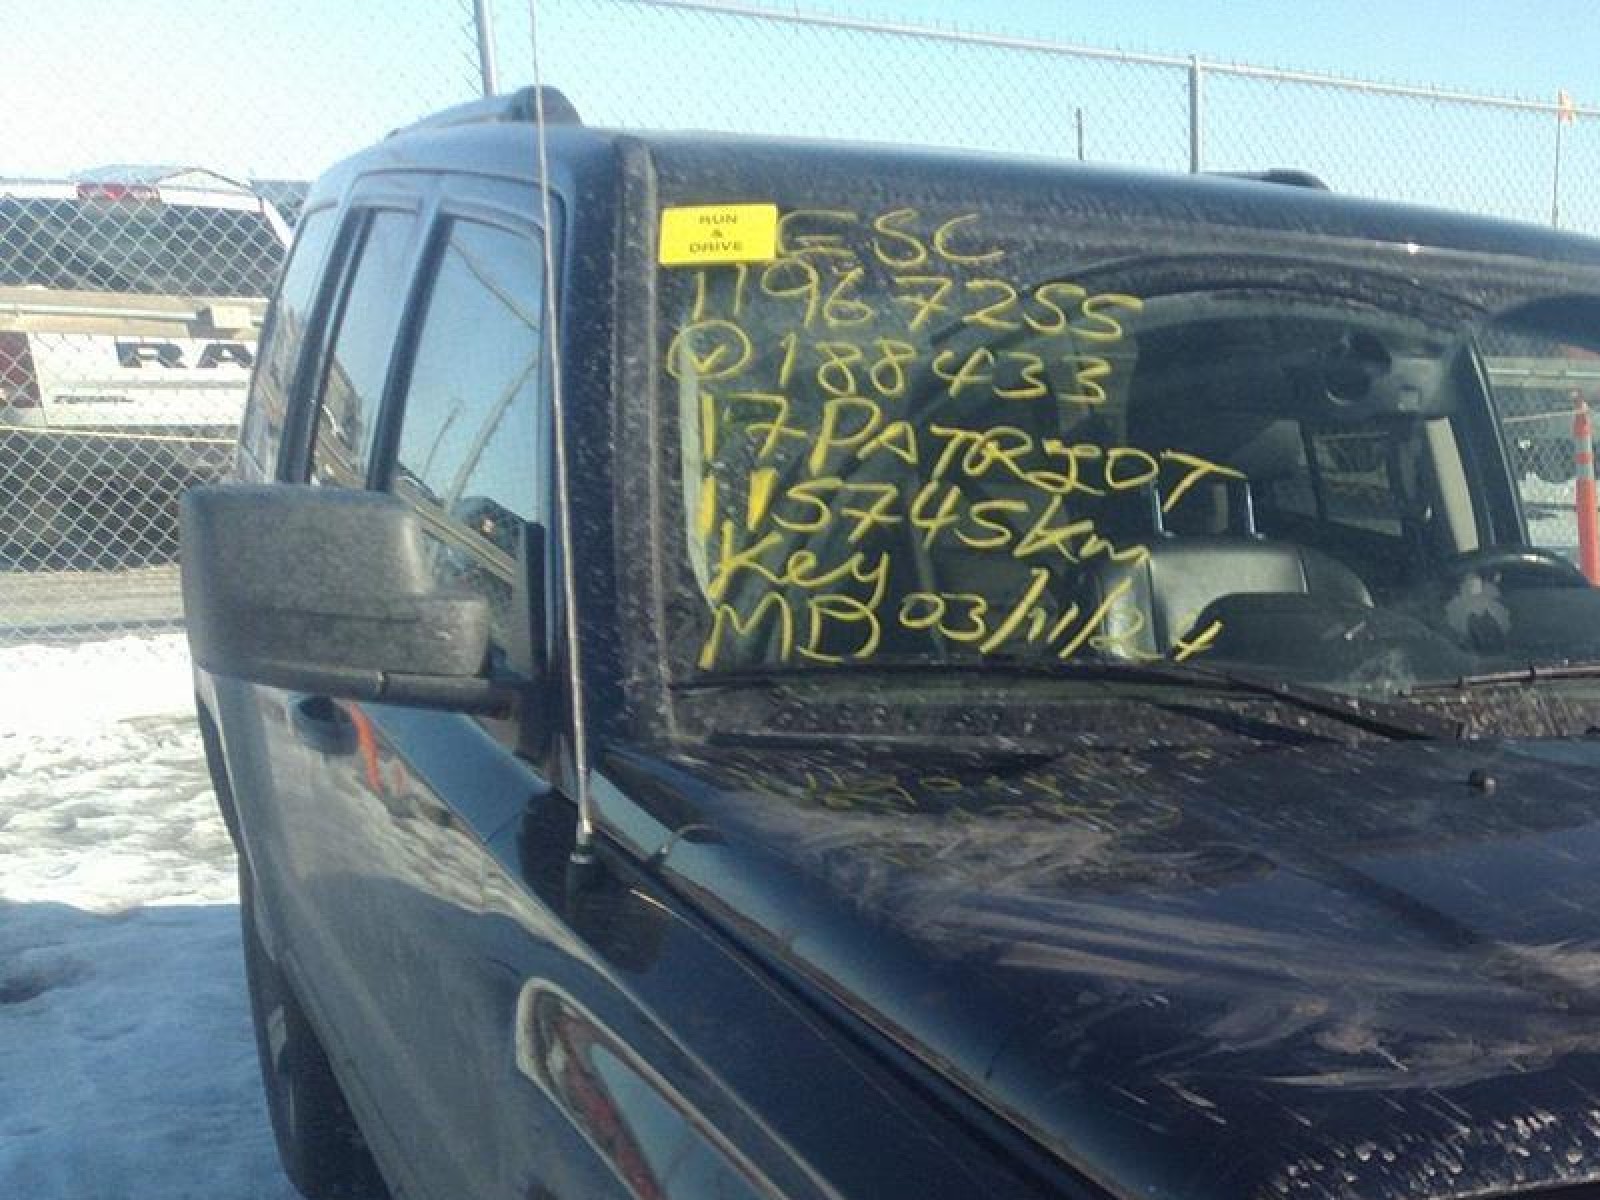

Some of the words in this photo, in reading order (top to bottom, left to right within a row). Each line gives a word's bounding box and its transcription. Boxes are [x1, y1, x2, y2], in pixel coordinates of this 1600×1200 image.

[699, 214, 738, 225] RUN
[689, 241, 743, 253] DRIVE
[115, 341, 253, 369] RA
